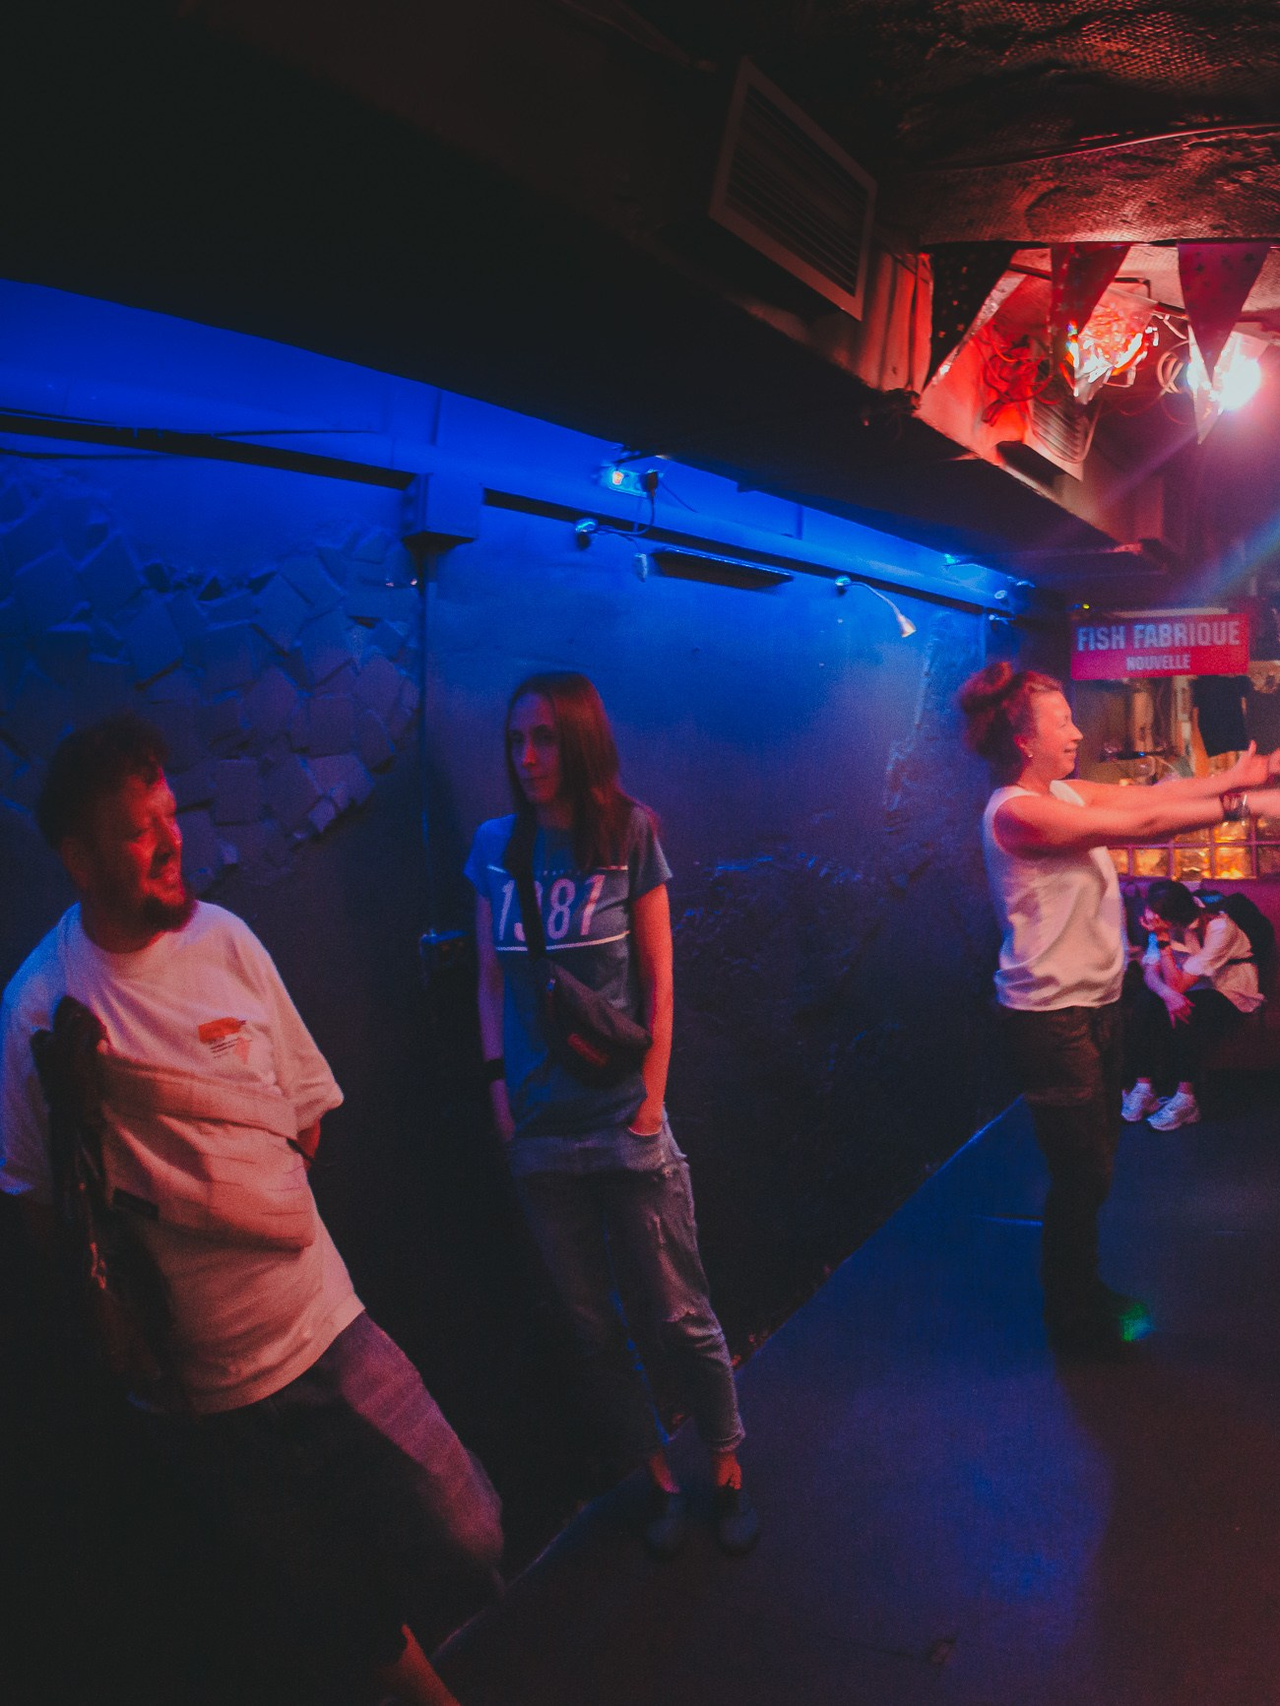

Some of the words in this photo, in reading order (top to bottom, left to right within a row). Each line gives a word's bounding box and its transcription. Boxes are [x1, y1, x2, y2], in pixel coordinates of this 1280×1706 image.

[1076, 625, 1126, 651] FISH
[1133, 621, 1240, 648] FABRIQUE
[1126, 654, 1191, 671] NOUVELLE
